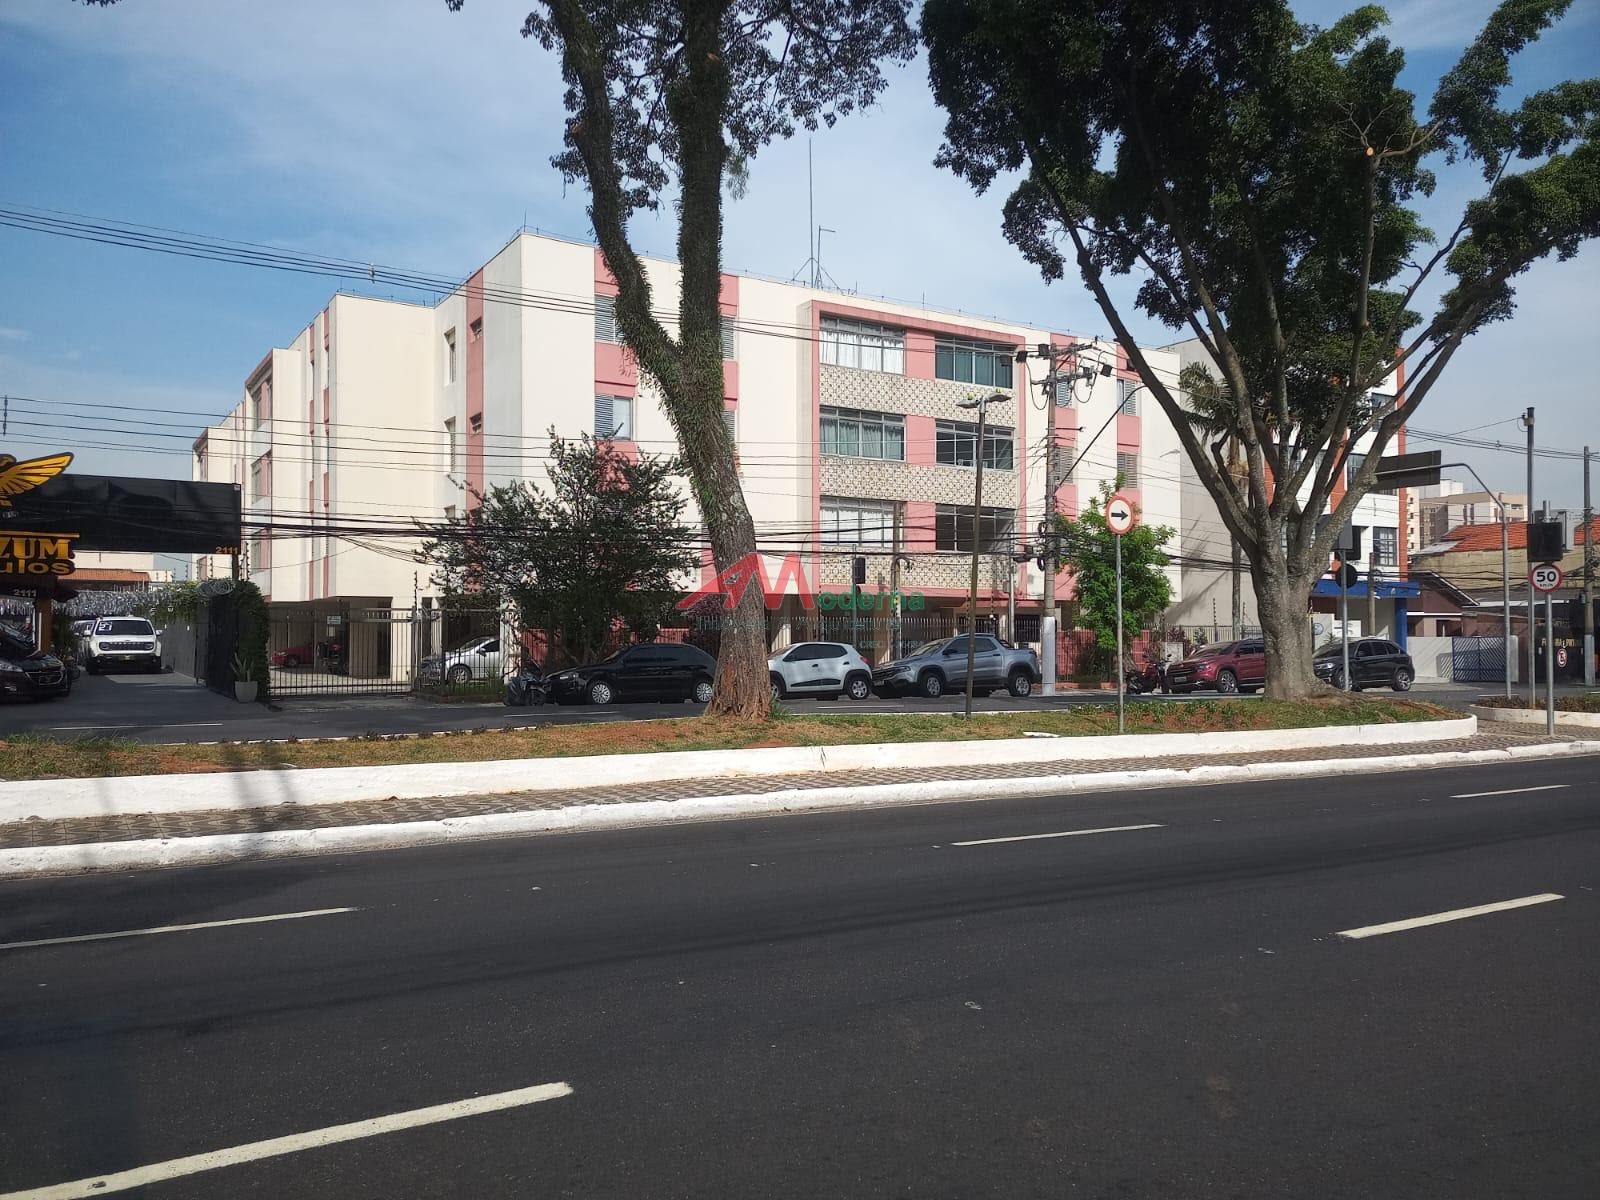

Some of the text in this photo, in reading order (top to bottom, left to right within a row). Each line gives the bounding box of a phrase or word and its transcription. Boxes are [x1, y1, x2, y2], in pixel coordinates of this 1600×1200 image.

[215, 546, 238, 555] 2111
[1536, 571, 1557, 582] 50
[13, 589, 37, 597] 2111
